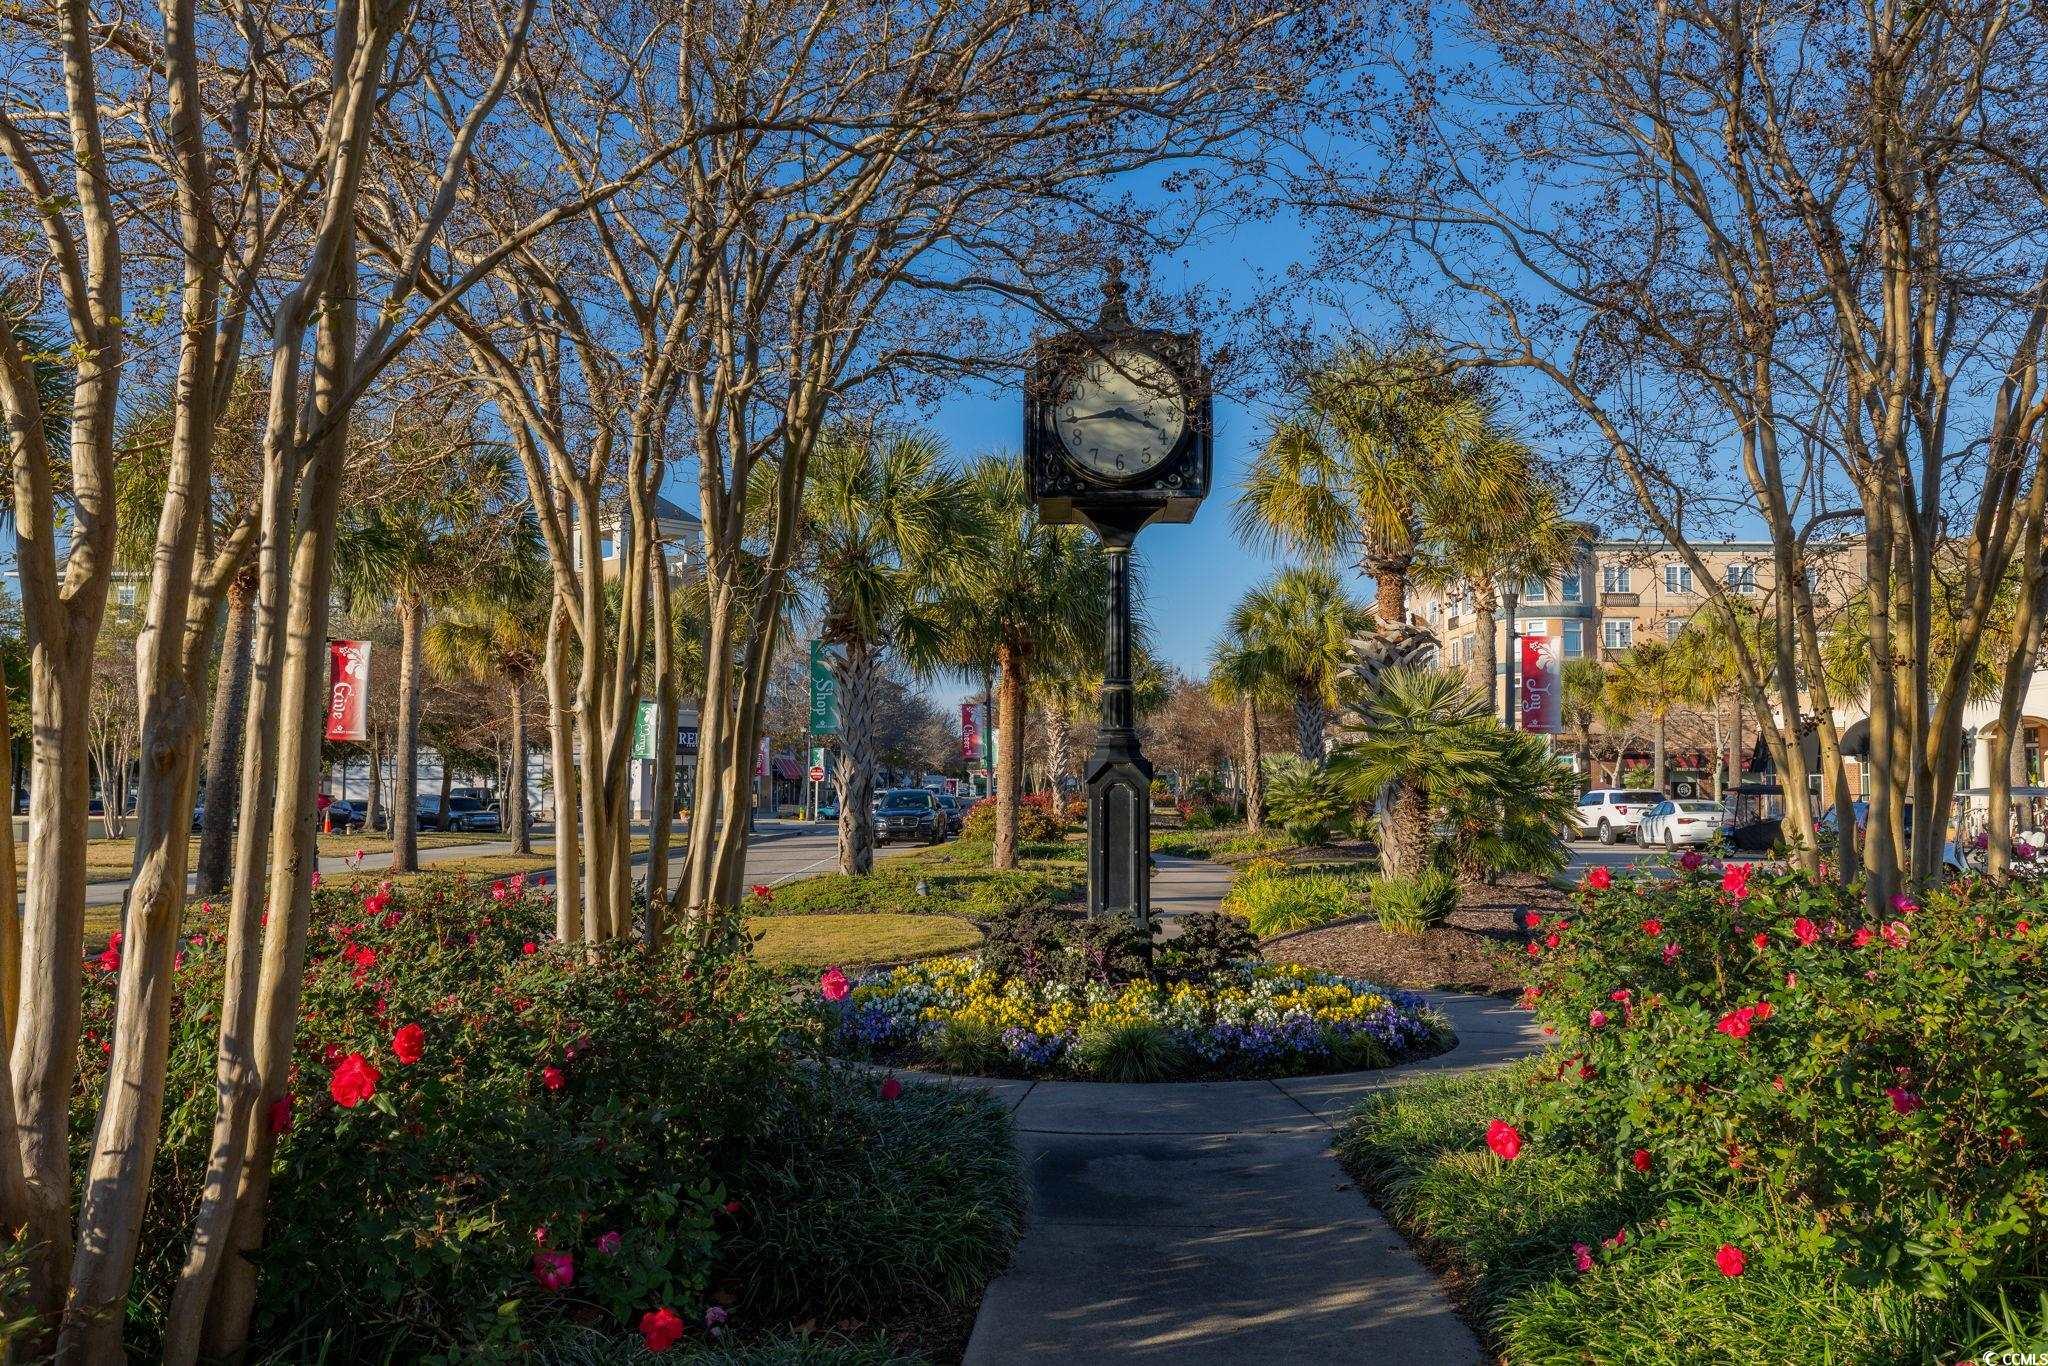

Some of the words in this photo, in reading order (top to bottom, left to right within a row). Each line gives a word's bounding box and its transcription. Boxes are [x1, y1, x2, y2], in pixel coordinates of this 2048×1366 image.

[1066, 407, 1075, 420] 9
[1072, 428, 1082, 446] 8
[1158, 428, 1168, 446] 4
[1089, 448, 1099, 465] 7
[1115, 454, 1124, 471] 6
[1141, 447, 1151, 464] 5
[333, 682, 352, 720] Give
[811, 677, 834, 715] Shop
[1522, 679, 1552, 712] Joy
